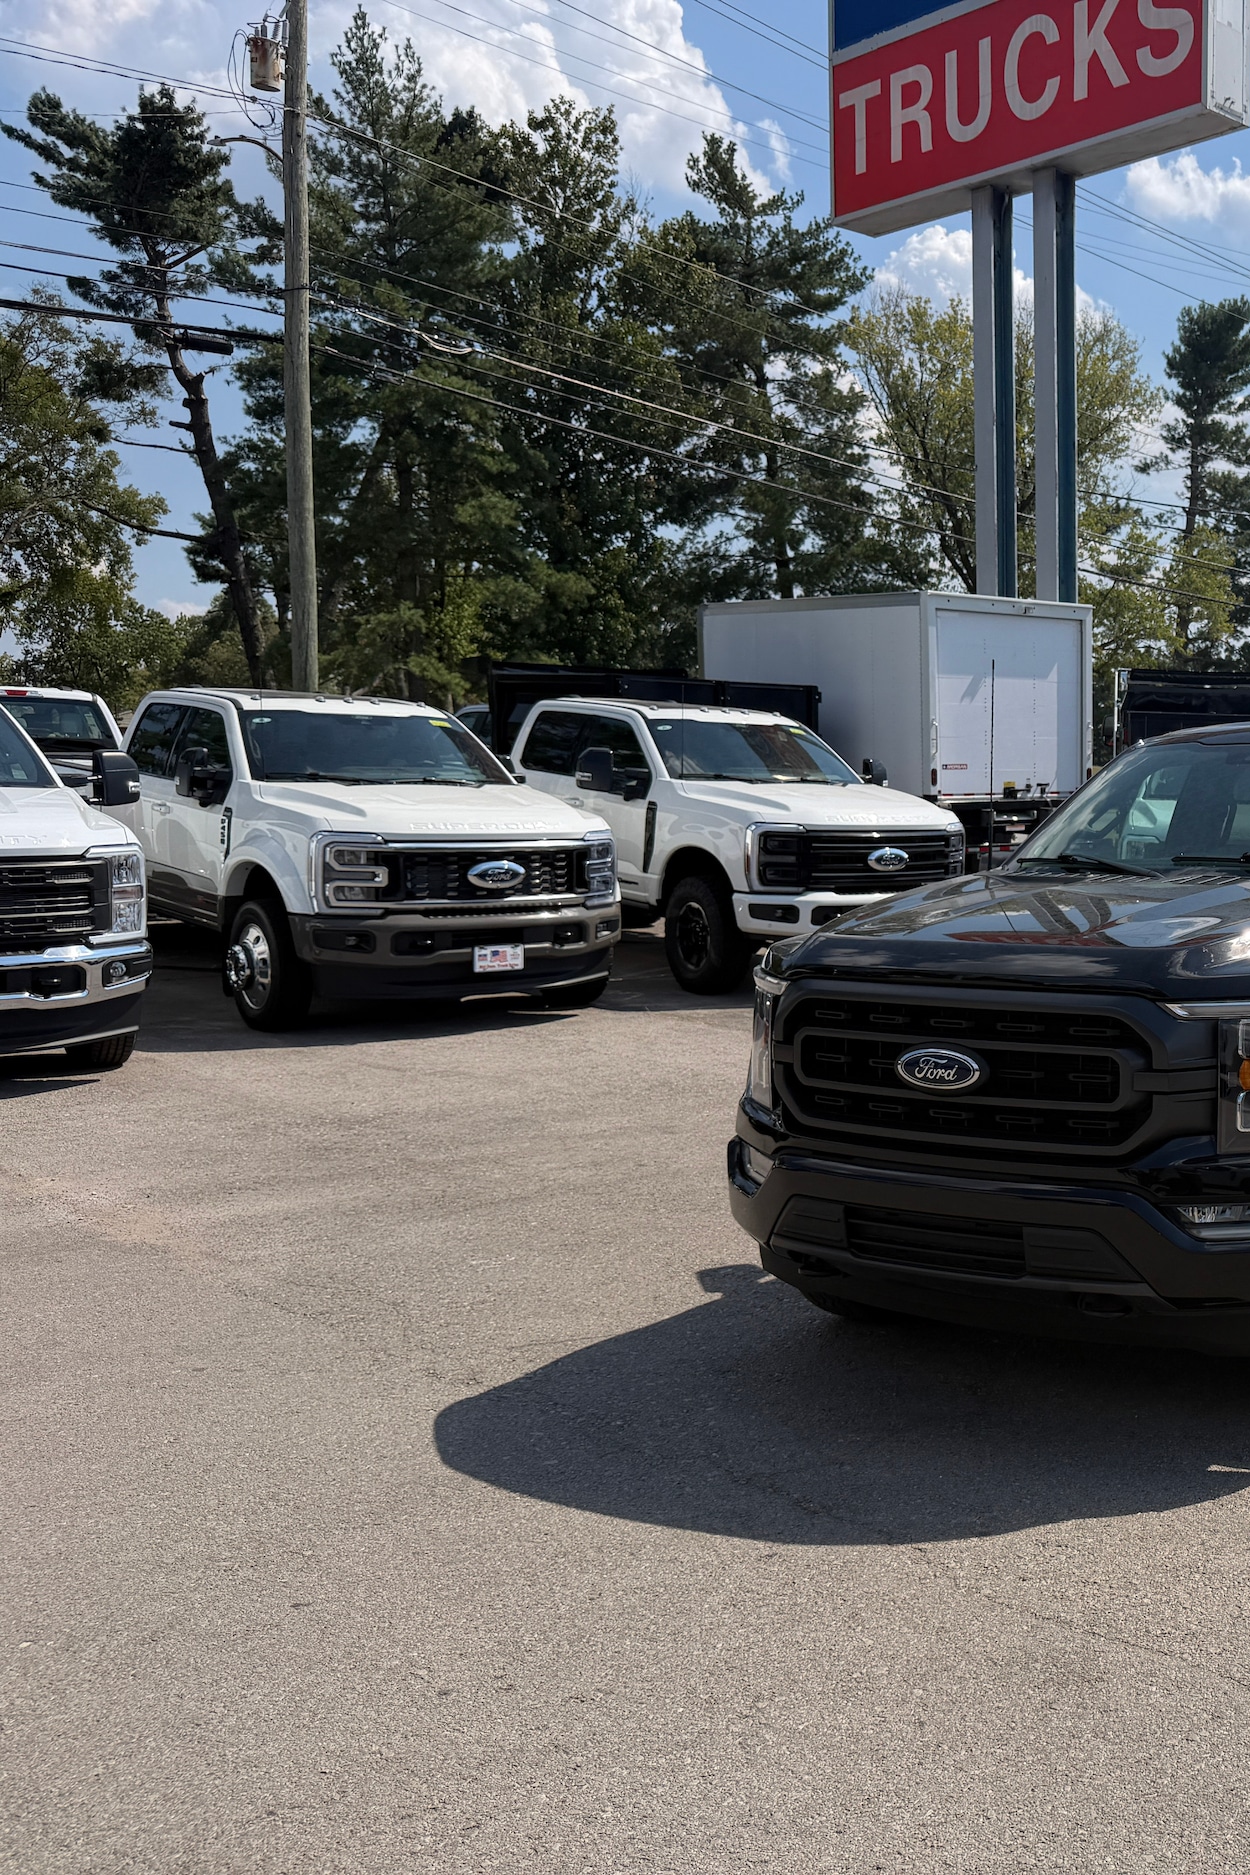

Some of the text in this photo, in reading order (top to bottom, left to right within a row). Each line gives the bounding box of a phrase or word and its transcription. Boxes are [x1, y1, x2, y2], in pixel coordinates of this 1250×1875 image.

[839, 0, 1195, 175] TRUCKS
[485, 868, 513, 881] Ford
[914, 1056, 959, 1081] Ford
